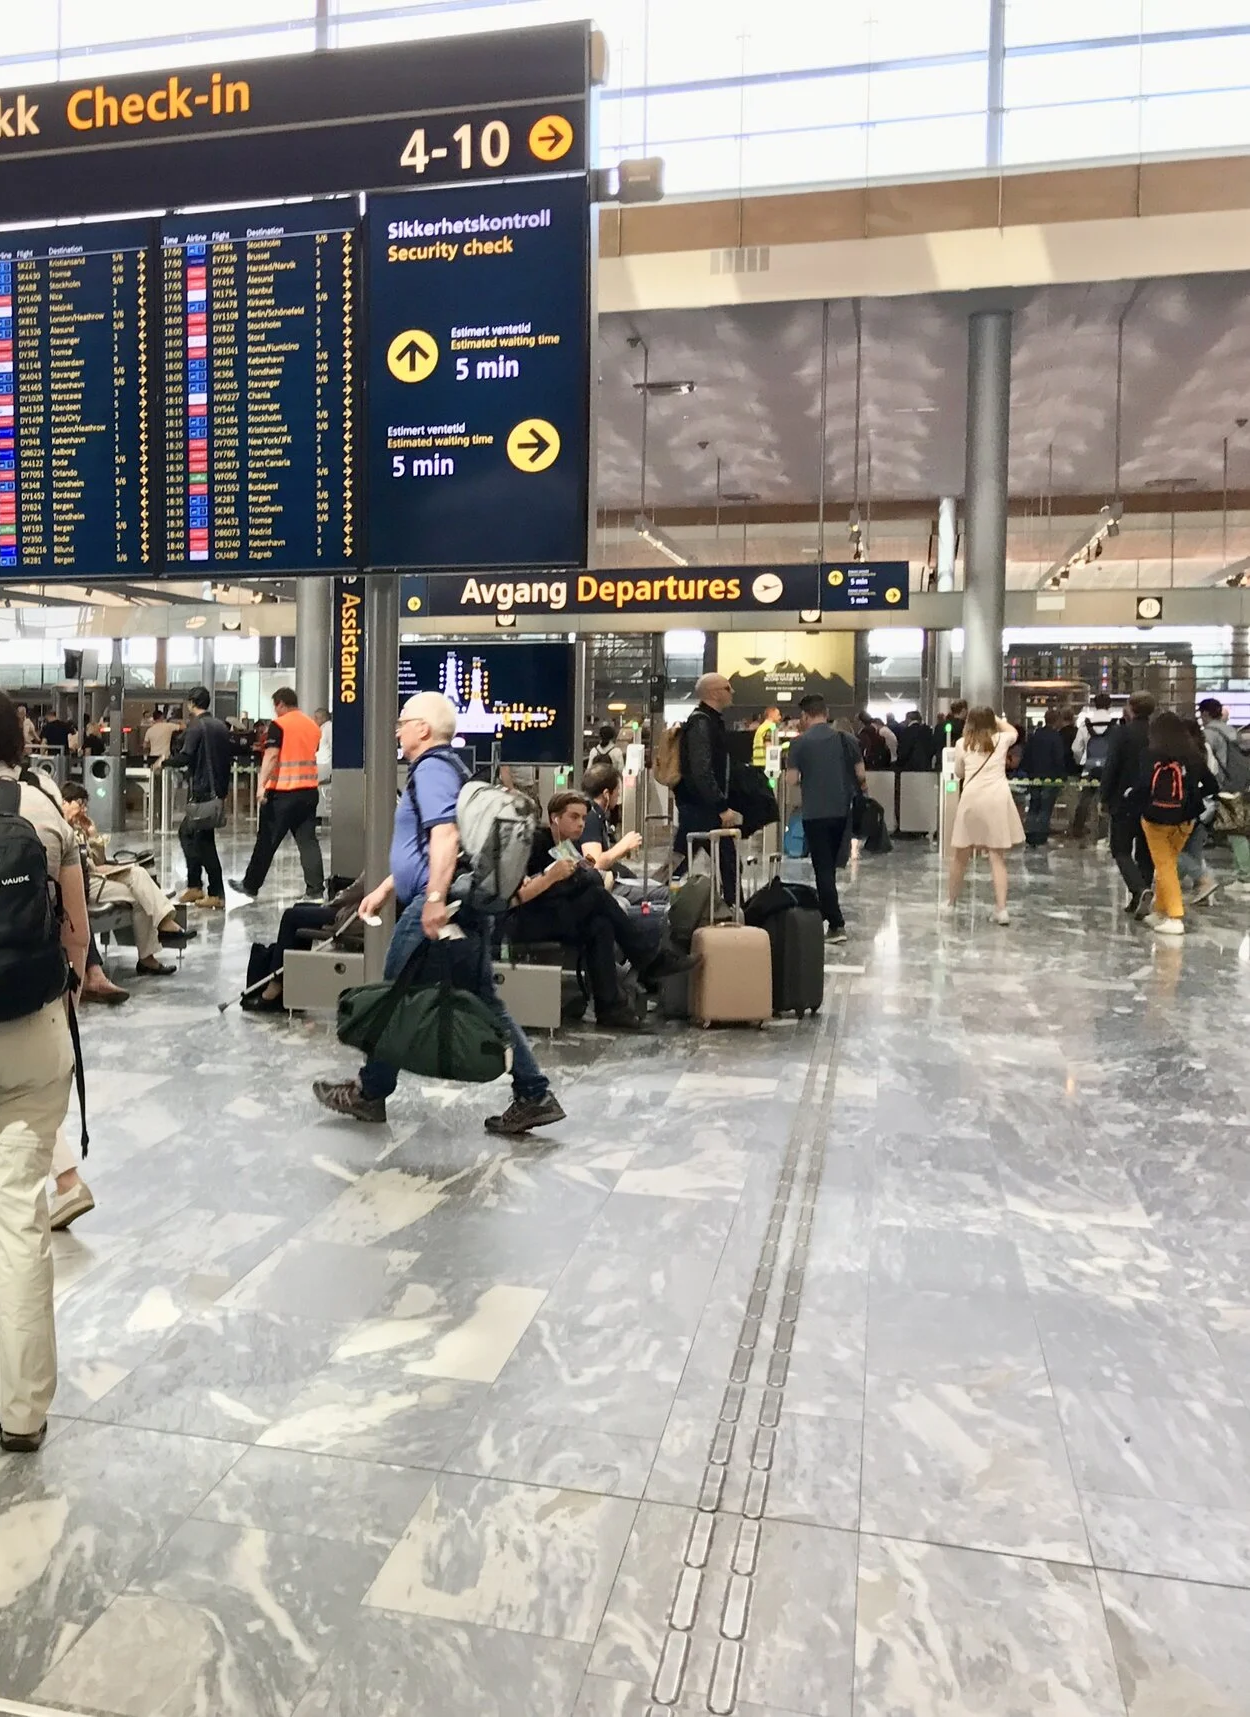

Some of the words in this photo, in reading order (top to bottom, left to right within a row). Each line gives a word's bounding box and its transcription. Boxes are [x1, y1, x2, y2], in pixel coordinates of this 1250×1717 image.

[66, 72, 250, 131] Check-in
[400, 120, 510, 174] 4-10
[164, 236, 178, 244] Time
[186, 234, 207, 243] Airline
[212, 232, 230, 240] Flight
[247, 227, 284, 237] Destination
[387, 209, 551, 240] Sikkerhetskontroll
[387, 240, 459, 262] Security
[463, 236, 514, 257] check
[451, 324, 490, 339] Estimert
[492, 322, 532, 336] ventetid
[451, 337, 497, 351] Estimated
[499, 335, 535, 350] waiting
[538, 333, 560, 346] time
[455, 358, 470, 381] 5
[476, 355, 520, 380] min
[387, 426, 425, 438] Estimert
[427, 423, 466, 436] ventetid
[387, 437, 433, 449] Estimated
[434, 435, 470, 450] waiting
[472, 433, 494, 446] time
[392, 455, 405, 478] 5
[413, 454, 454, 477] min
[460, 578, 567, 611] Avgang
[577, 575, 741, 609] Departures
[341, 592, 361, 704] Assistance
[1, 875, 30, 886] VAUDE
